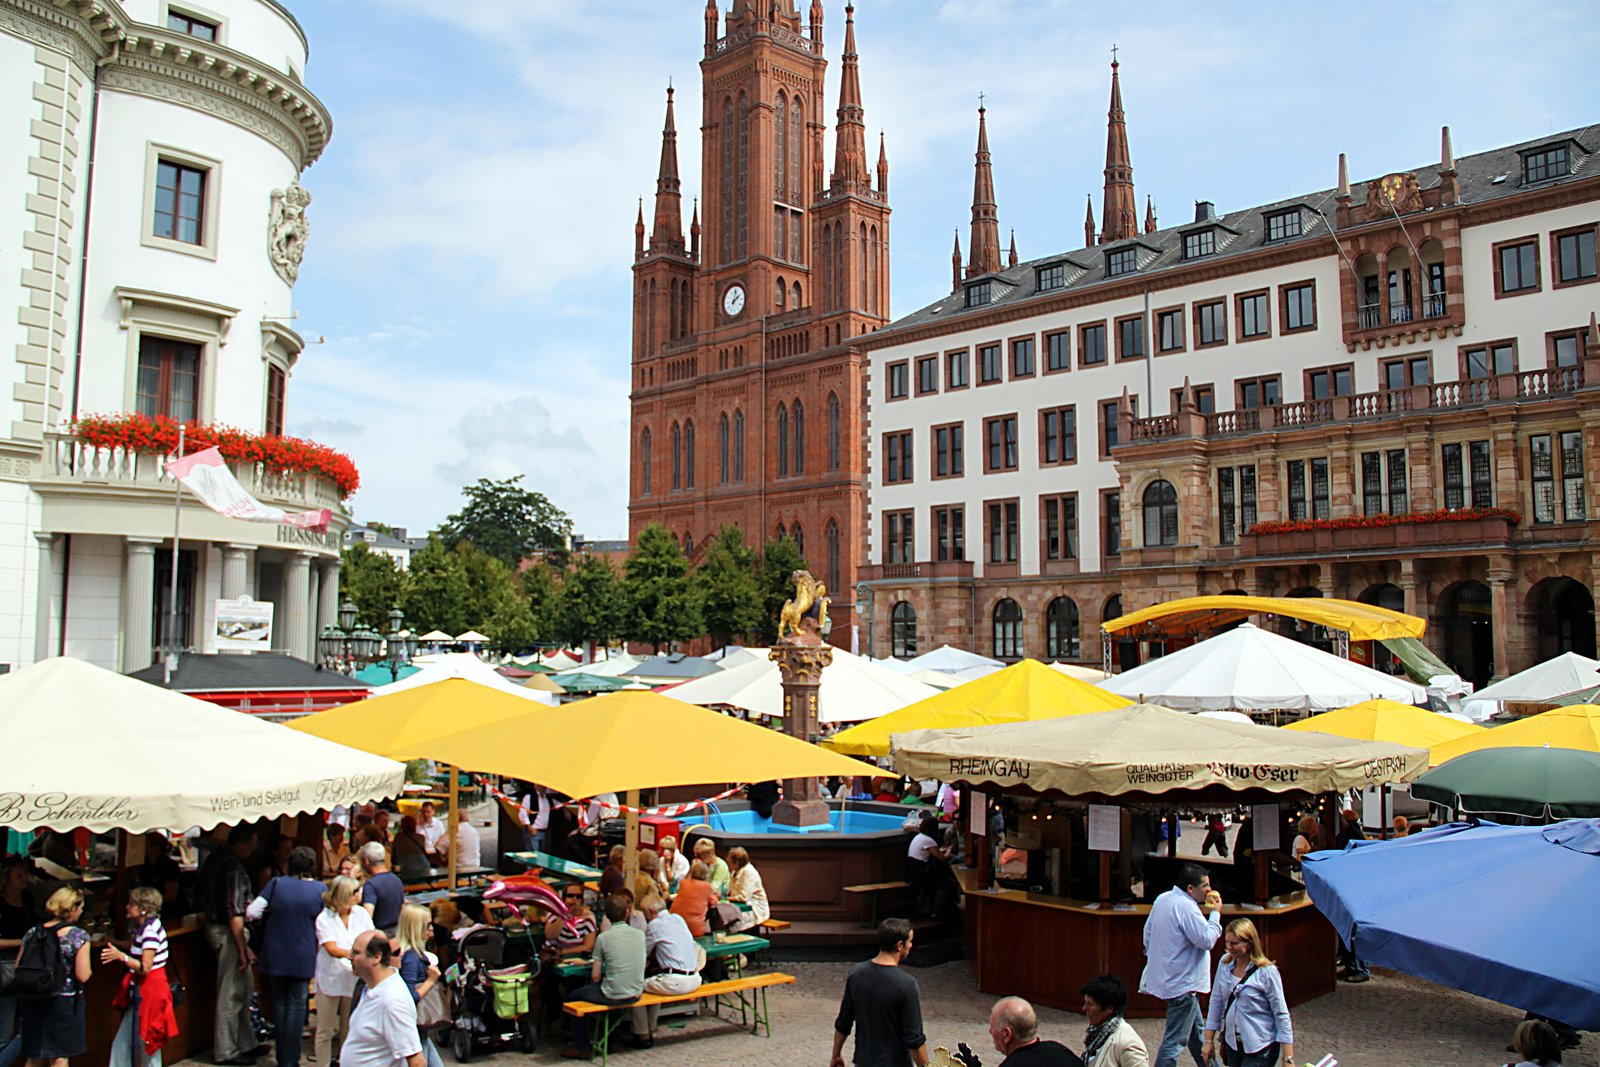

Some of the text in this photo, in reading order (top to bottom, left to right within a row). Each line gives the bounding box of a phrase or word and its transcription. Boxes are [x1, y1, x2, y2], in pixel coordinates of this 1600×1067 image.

[950, 758, 1030, 779] RHEINGAU
[27, 792, 139, 821] Schönleber
[210, 789, 300, 812] Wein- und Sektgut
